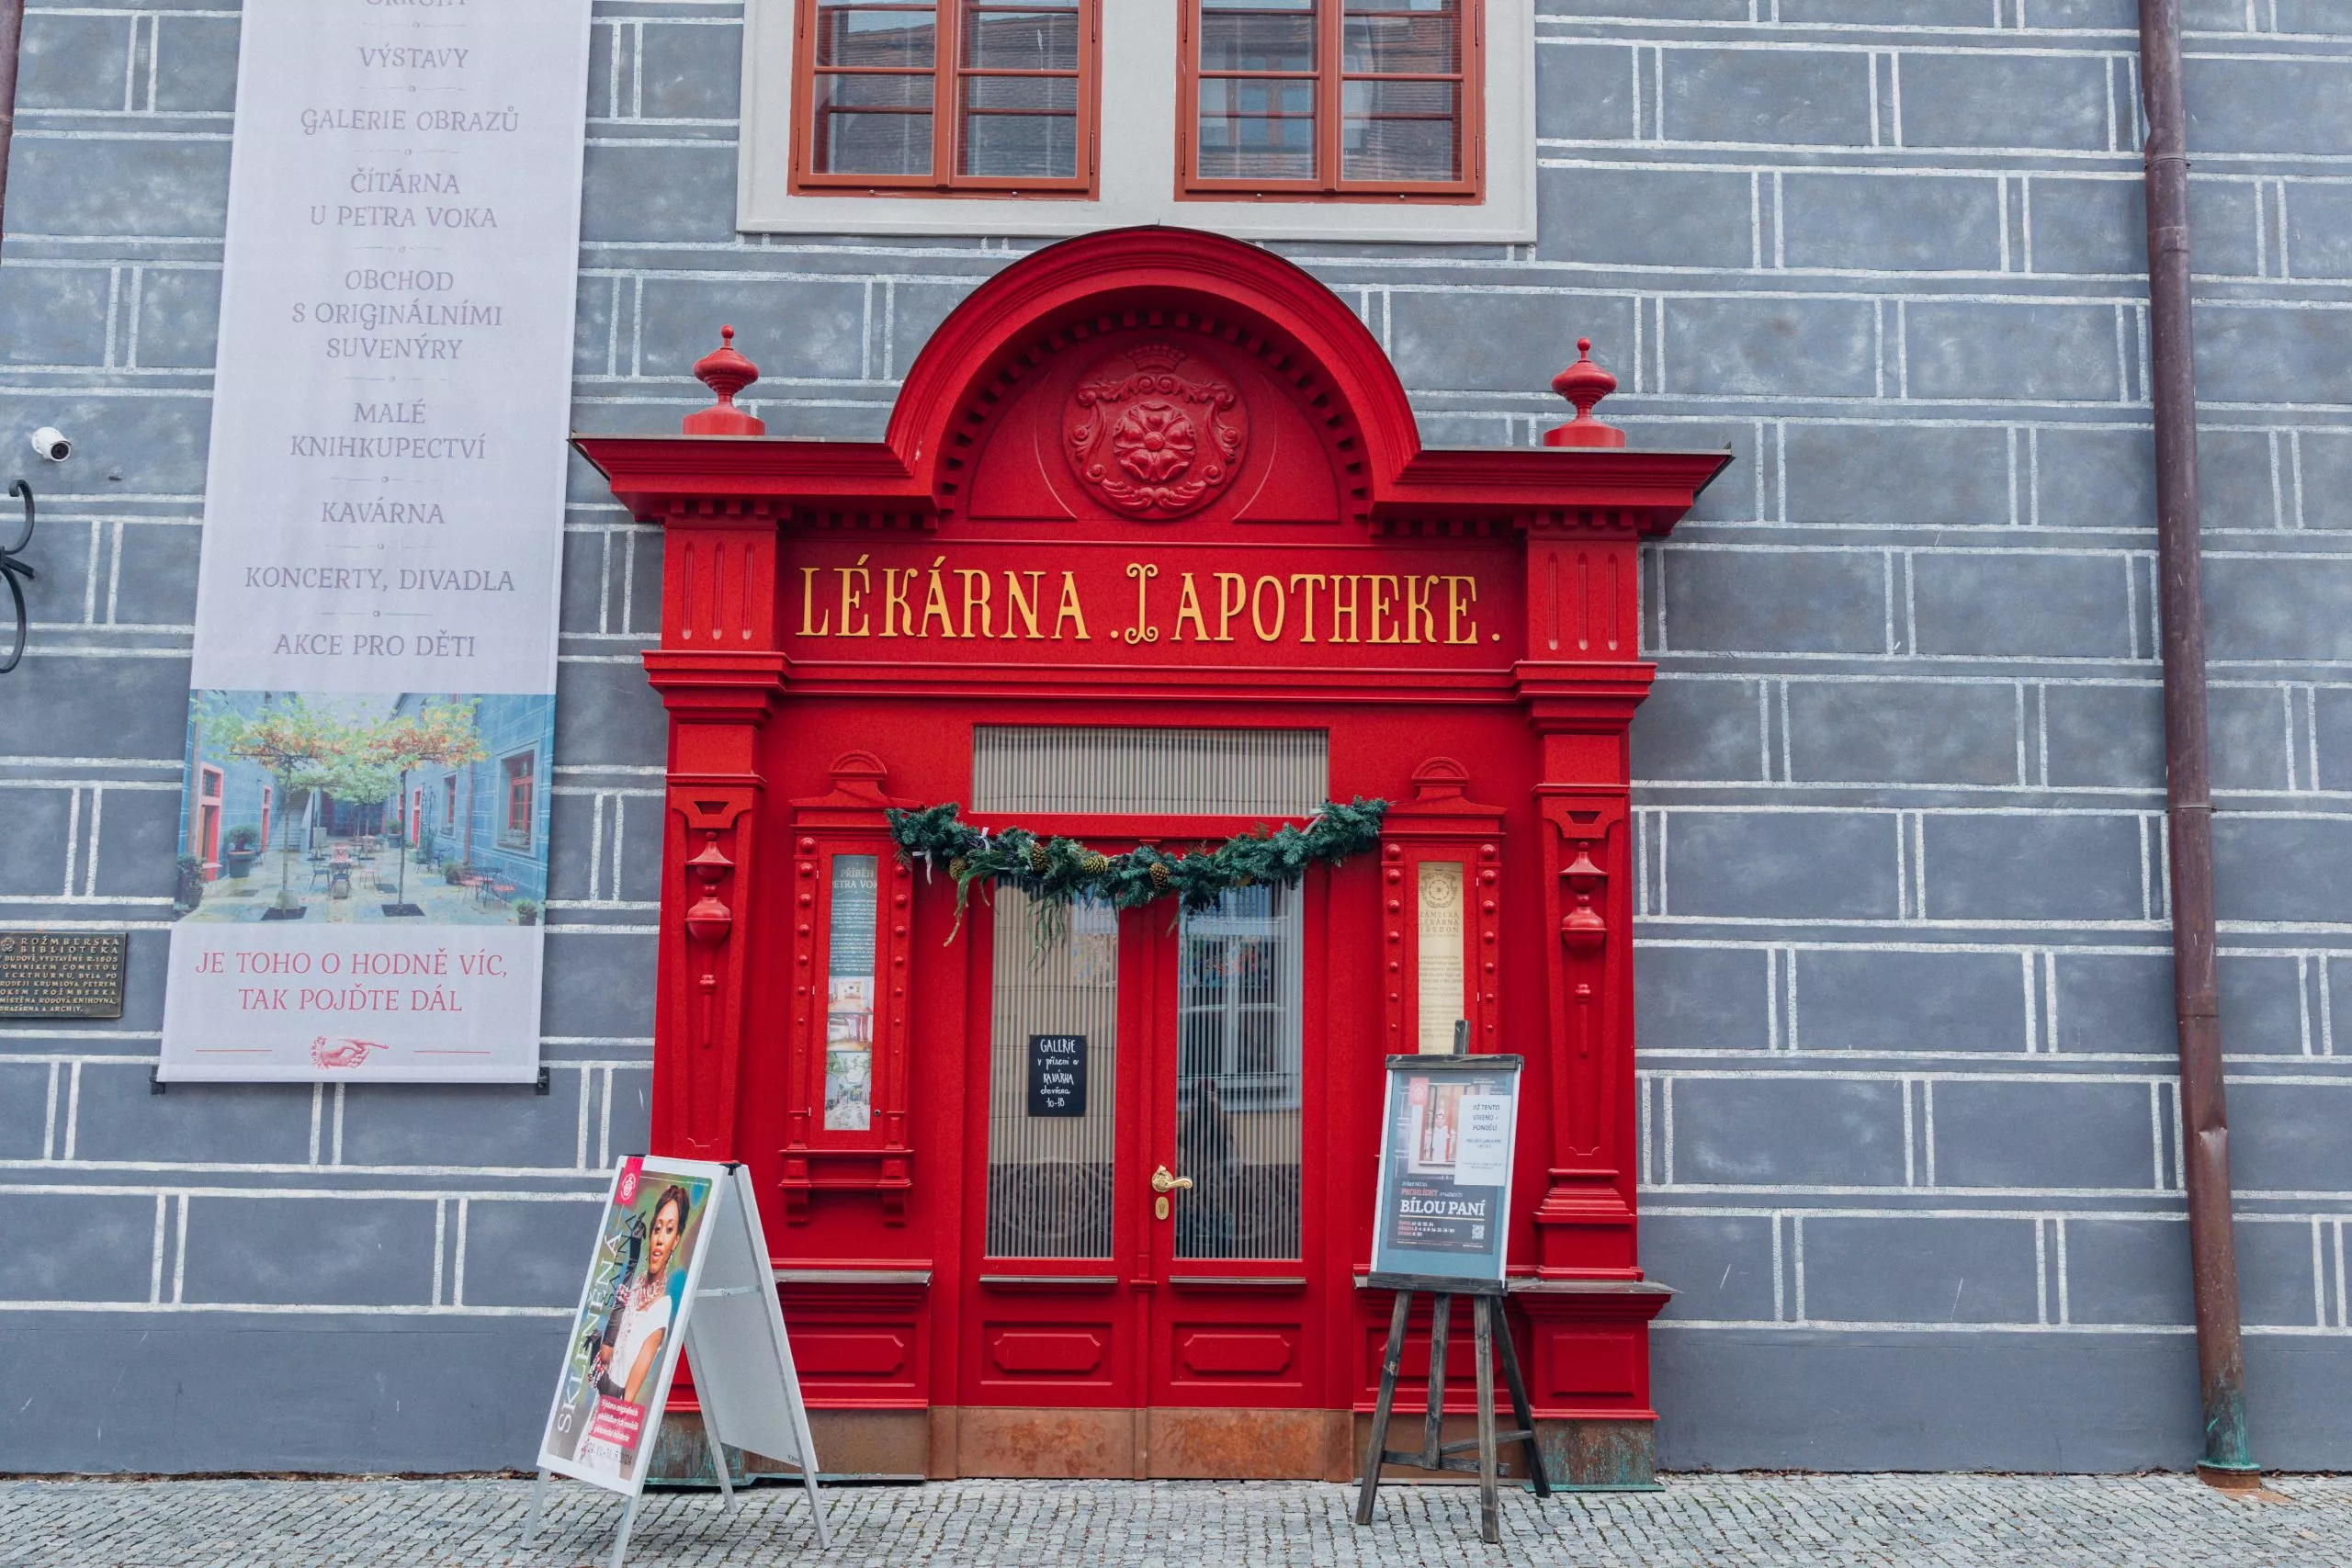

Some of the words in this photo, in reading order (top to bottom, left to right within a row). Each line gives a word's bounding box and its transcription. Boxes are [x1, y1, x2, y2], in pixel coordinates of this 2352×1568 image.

[356, 42, 469, 70] VÝSTAVY
[300, 108, 408, 136] GALERIE
[415, 105, 520, 133] OBRAZŮ
[349, 167, 461, 196] ČÍTÁRNA
[310, 205, 327, 227] U
[336, 206, 417, 229] PETRA
[426, 207, 499, 230] VOKA
[344, 269, 456, 293] OBCHOD
[290, 302, 306, 324] S
[314, 297, 503, 331] ORIGINÁLNÍMI
[325, 333, 465, 360] SUVENÝRY
[353, 398, 427, 424] MALÉ
[290, 434, 487, 460] KNIHKUPECTVÍ
[321, 497, 446, 525] KAVÁRNA
[243, 566, 390, 593] KONCERTY,
[398, 569, 516, 592] DIVADLA
[795, 554, 1091, 641] LÉKÁRNA
[273, 633, 343, 656] AKCE
[352, 635, 406, 658] PRO
[414, 629, 476, 658] DĚTI
[841, 867, 874, 878] PŘÍBĚH
[21, 945, 119, 954] BIBLIOTEKA
[195, 951, 226, 975] JE
[235, 952, 312, 975] TOHO
[321, 952, 341, 975] O
[351, 947, 448, 976] HODNĚ
[458, 948, 508, 977] VÍC,
[42, 987, 116, 996] ROŽMBERKA
[238, 987, 288, 1010] TAK
[299, 983, 400, 1012] POJĎTE
[411, 985, 464, 1012] DÁL
[1040, 1038, 1076, 1054] GALERIE
[1043, 1068, 1075, 1085] KAVÁRNA
[1399, 1196, 1446, 1214] BÍLOU
[1447, 1199, 1487, 1216] PANÍ
